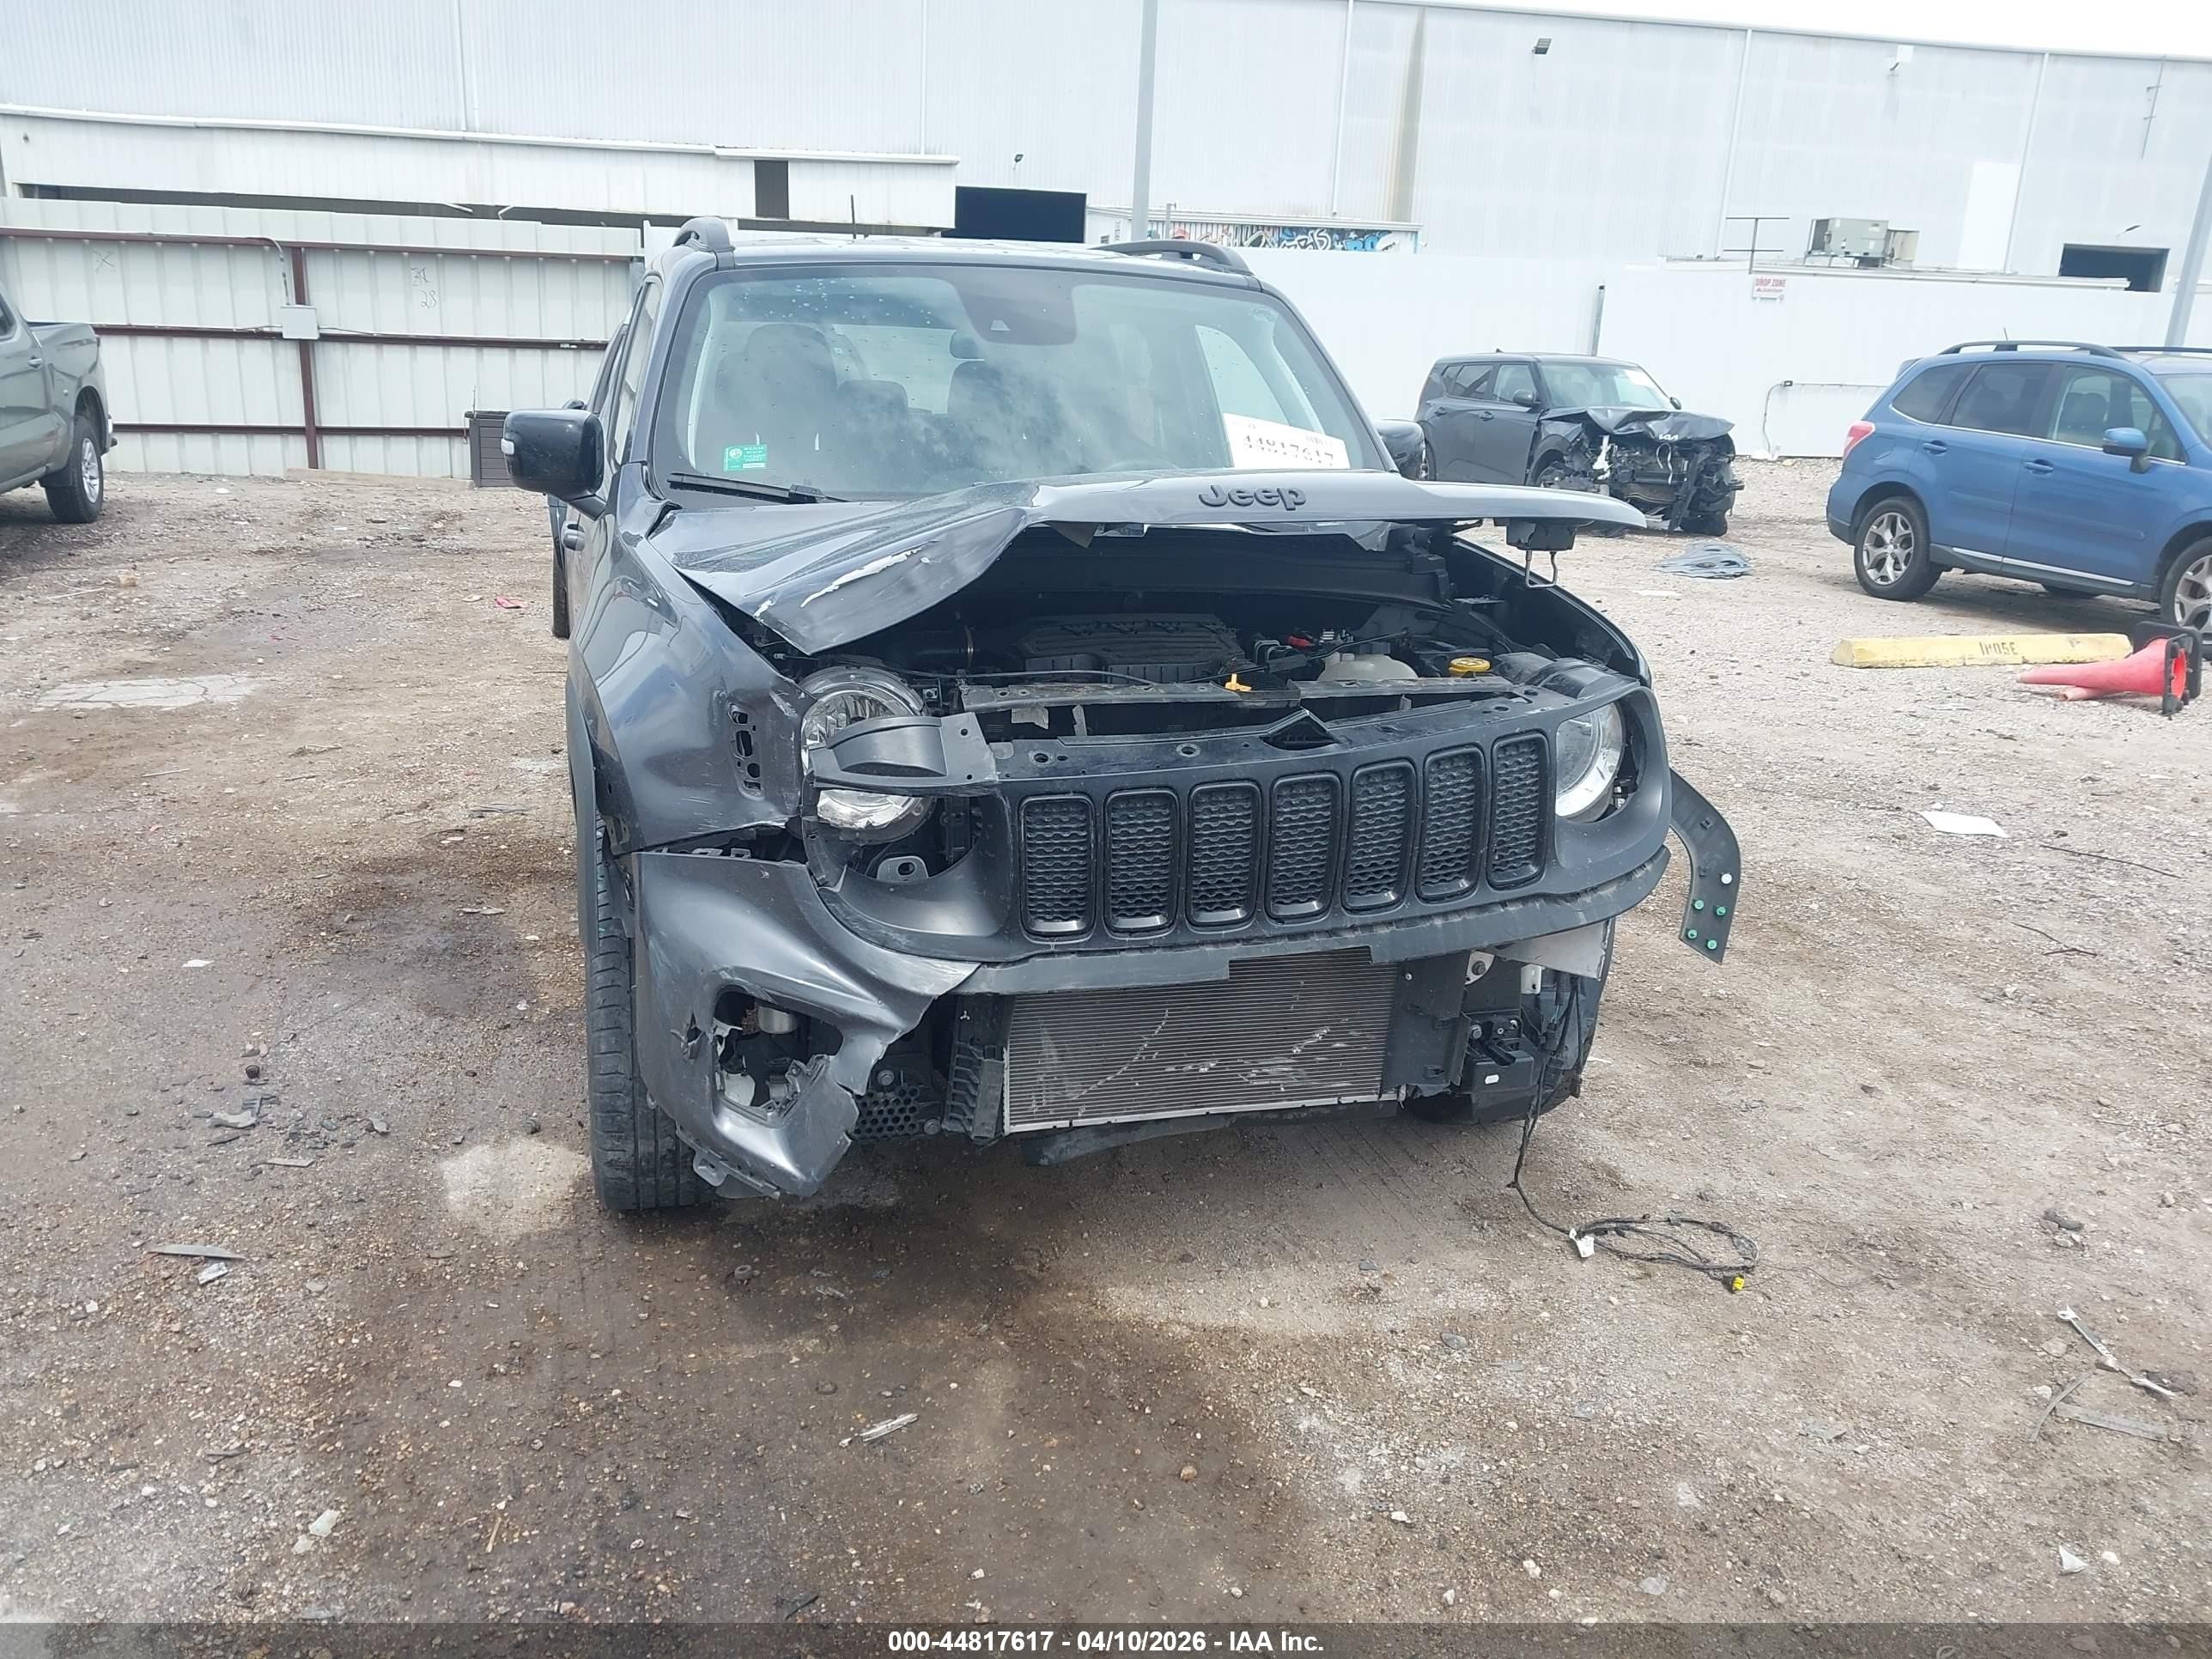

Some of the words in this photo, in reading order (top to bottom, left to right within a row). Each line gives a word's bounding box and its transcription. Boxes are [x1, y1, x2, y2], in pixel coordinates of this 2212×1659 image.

[1756, 277, 1771, 287] DROP
[1771, 278, 1787, 288] ZONE
[1199, 484, 1307, 511] Jeep
